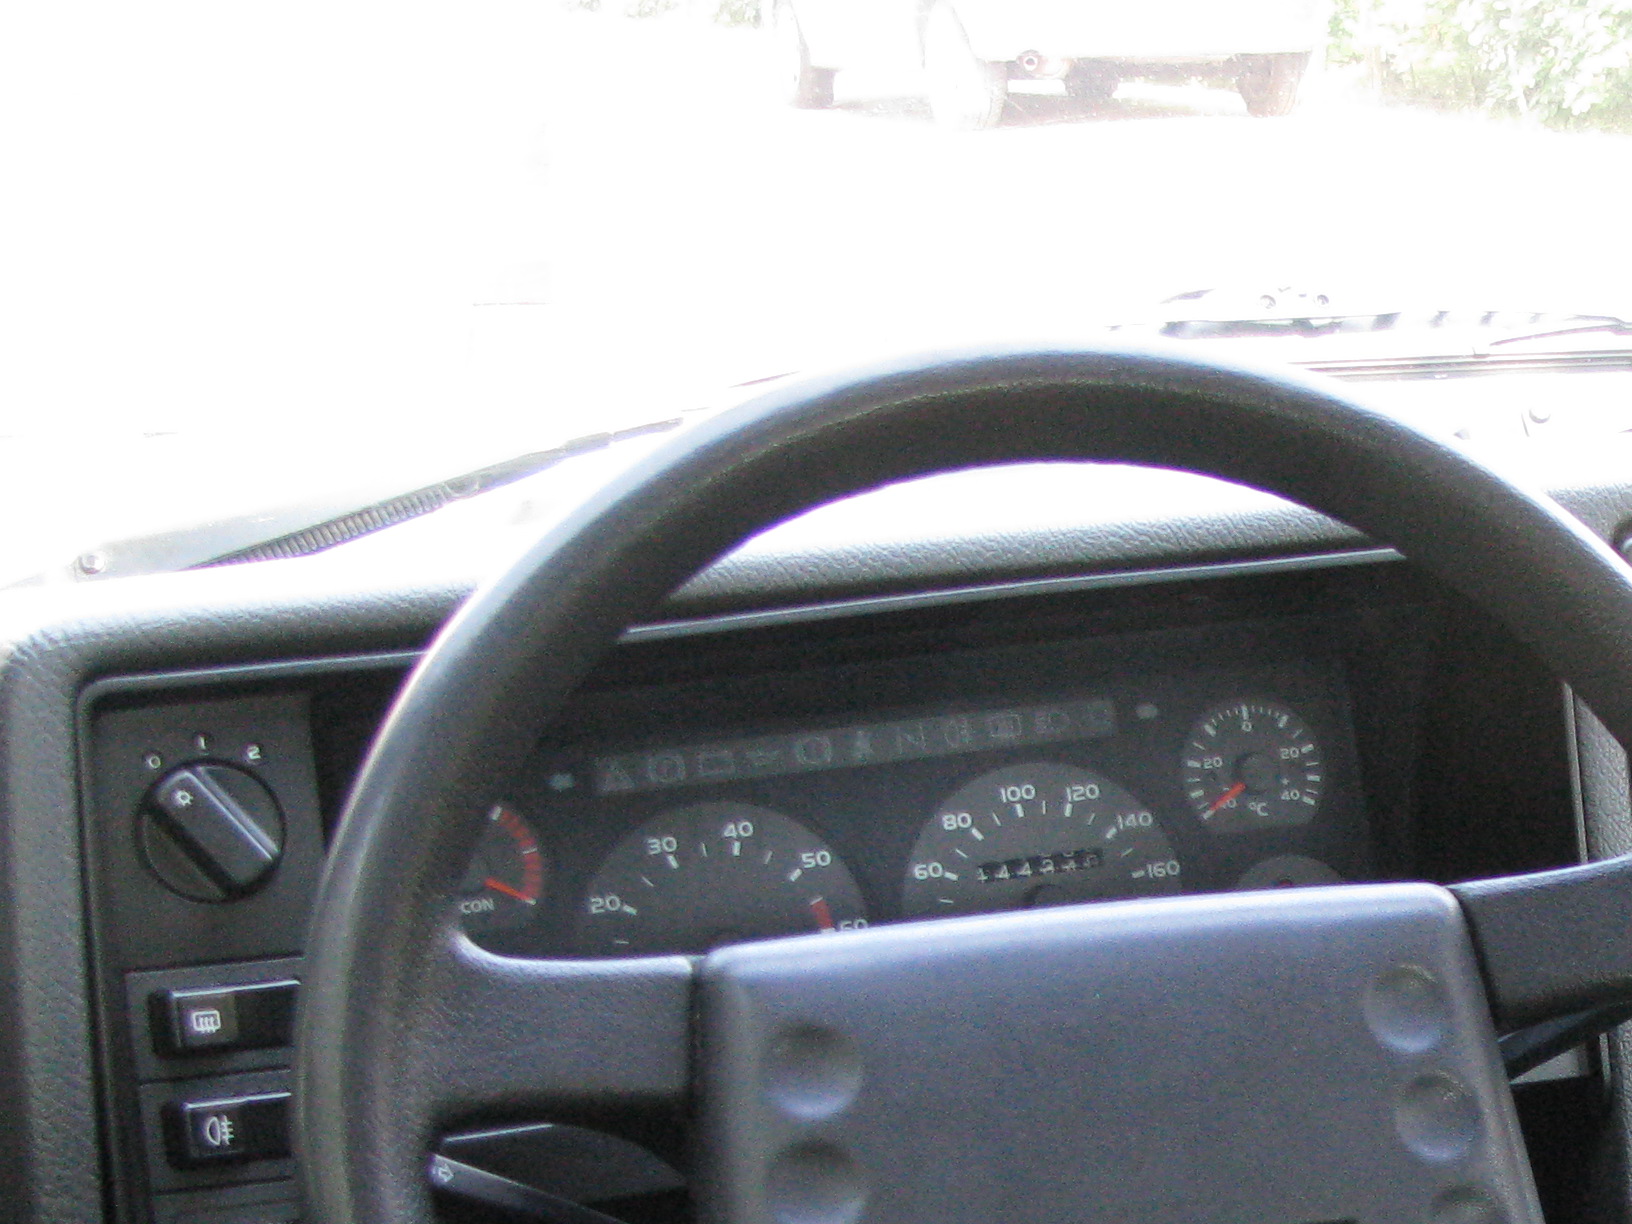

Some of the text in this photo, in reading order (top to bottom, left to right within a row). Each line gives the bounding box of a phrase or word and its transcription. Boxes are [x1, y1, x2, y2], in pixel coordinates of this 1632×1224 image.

[1241, 721, 1252, 732] 0
[247, 745, 261, 759] 2
[1280, 748, 1300, 760] 20
[149, 755, 161, 769] 0
[1203, 756, 1223, 770] 20
[1000, 784, 1036, 803] 100
[1066, 784, 1100, 801] 120
[1281, 789, 1300, 801] 40
[942, 812, 972, 831] 80
[1116, 811, 1153, 829] 140
[722, 821, 754, 839] 40
[647, 836, 678, 855] 30
[801, 850, 831, 869] 50
[914, 861, 943, 880] 60
[1146, 860, 1180, 879] 160
[591, 895, 621, 914] 20
